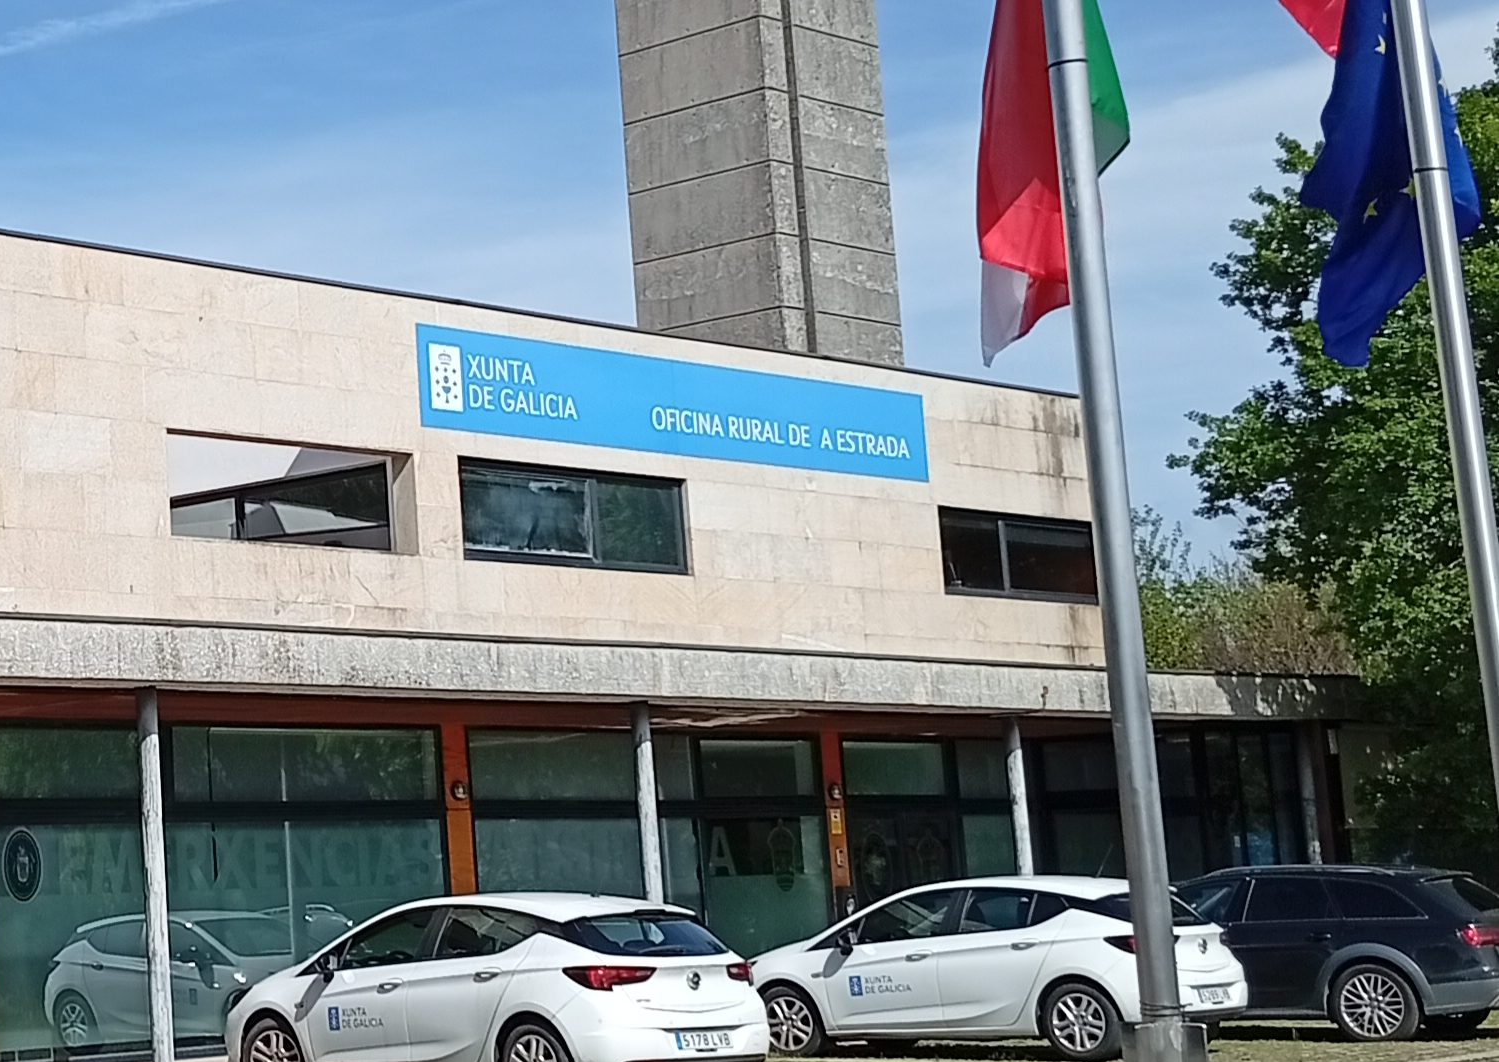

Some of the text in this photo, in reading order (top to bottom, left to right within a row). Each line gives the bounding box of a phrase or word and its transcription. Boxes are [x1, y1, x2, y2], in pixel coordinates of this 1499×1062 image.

[467, 354, 536, 386] XUNTA
[468, 384, 578, 420] DE GALICIA
[651, 406, 911, 459] OFICINA RURAL DE A ESTRADA
[863, 975, 893, 985] XUNTA
[864, 983, 912, 994] DE GALICIA
[342, 1006, 367, 1017] XUNTA
[342, 1017, 384, 1029] DE GALICIA
[682, 1032, 731, 1047] 5178 LVB
